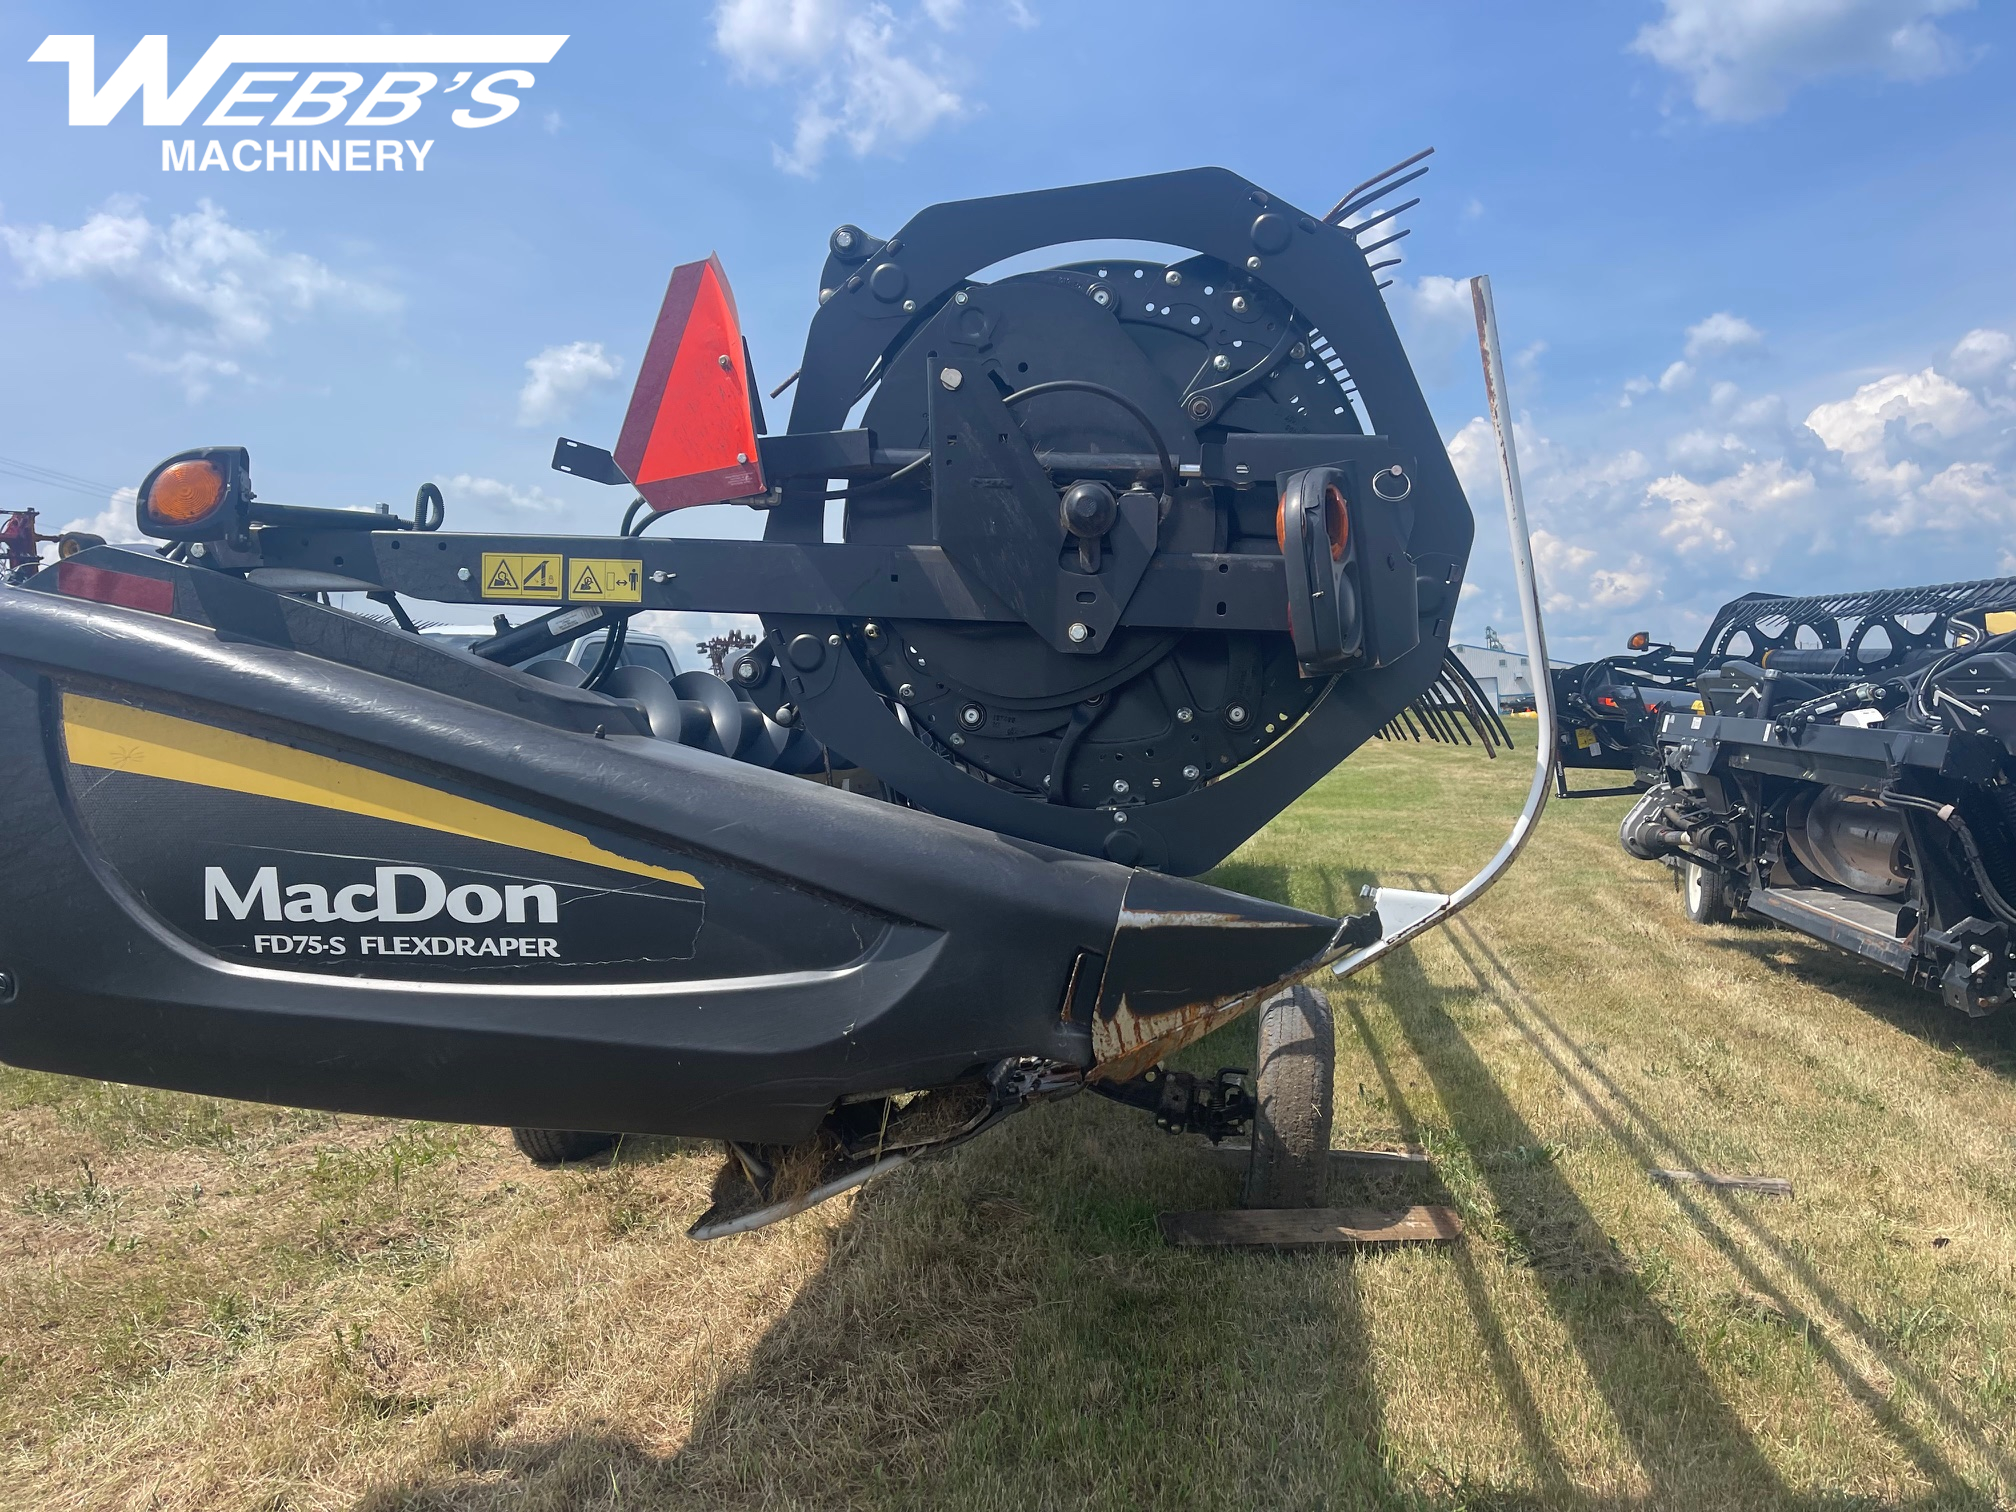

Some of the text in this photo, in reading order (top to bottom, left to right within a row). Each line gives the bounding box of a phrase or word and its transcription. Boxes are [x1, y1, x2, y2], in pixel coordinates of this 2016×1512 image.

[205, 866, 558, 924] MacDon
[254, 934, 561, 958] FD75-S FLEXDRAPER
